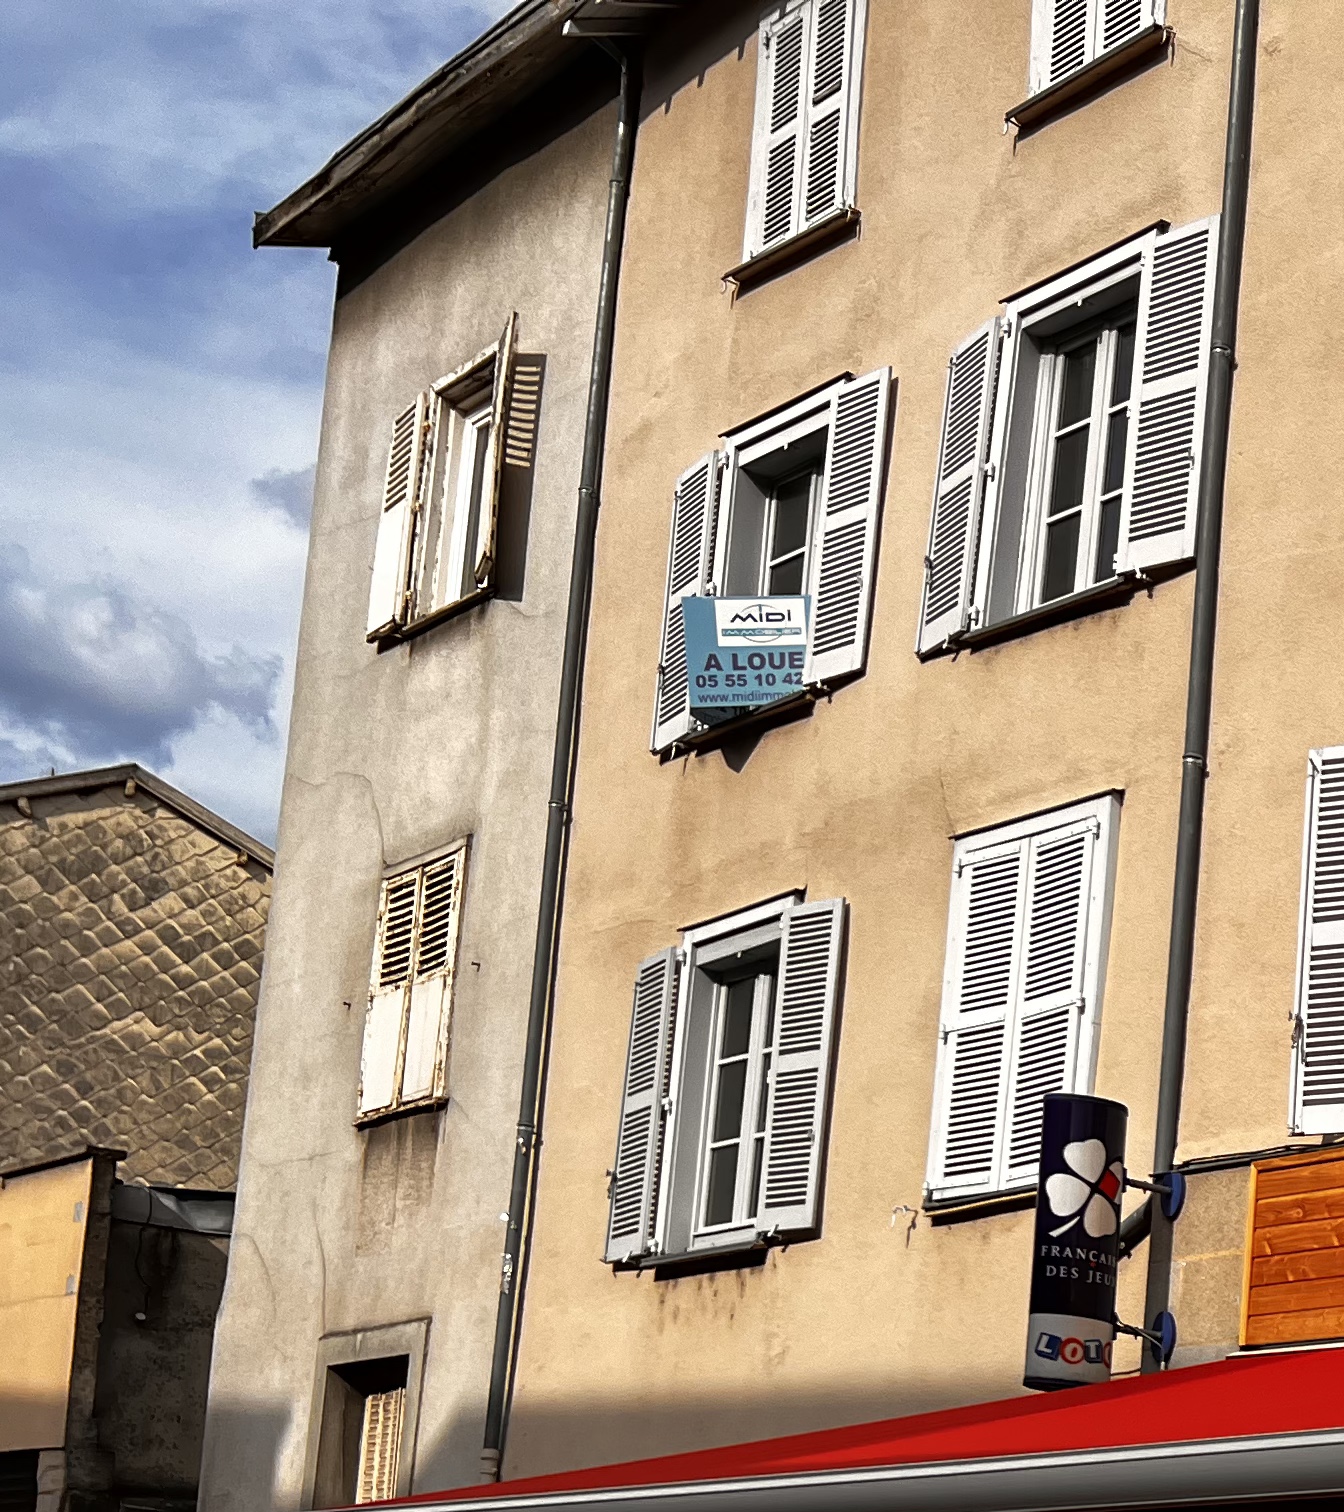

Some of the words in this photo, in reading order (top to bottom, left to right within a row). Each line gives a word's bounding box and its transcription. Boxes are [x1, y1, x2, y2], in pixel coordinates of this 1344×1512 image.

[704, 653, 724, 671] A
[696, 674, 718, 688] 05
[725, 674, 747, 688] 55
[754, 673, 776, 687] 10
[782, 672, 803, 685] 42
[1046, 1265, 1079, 1279] DES
